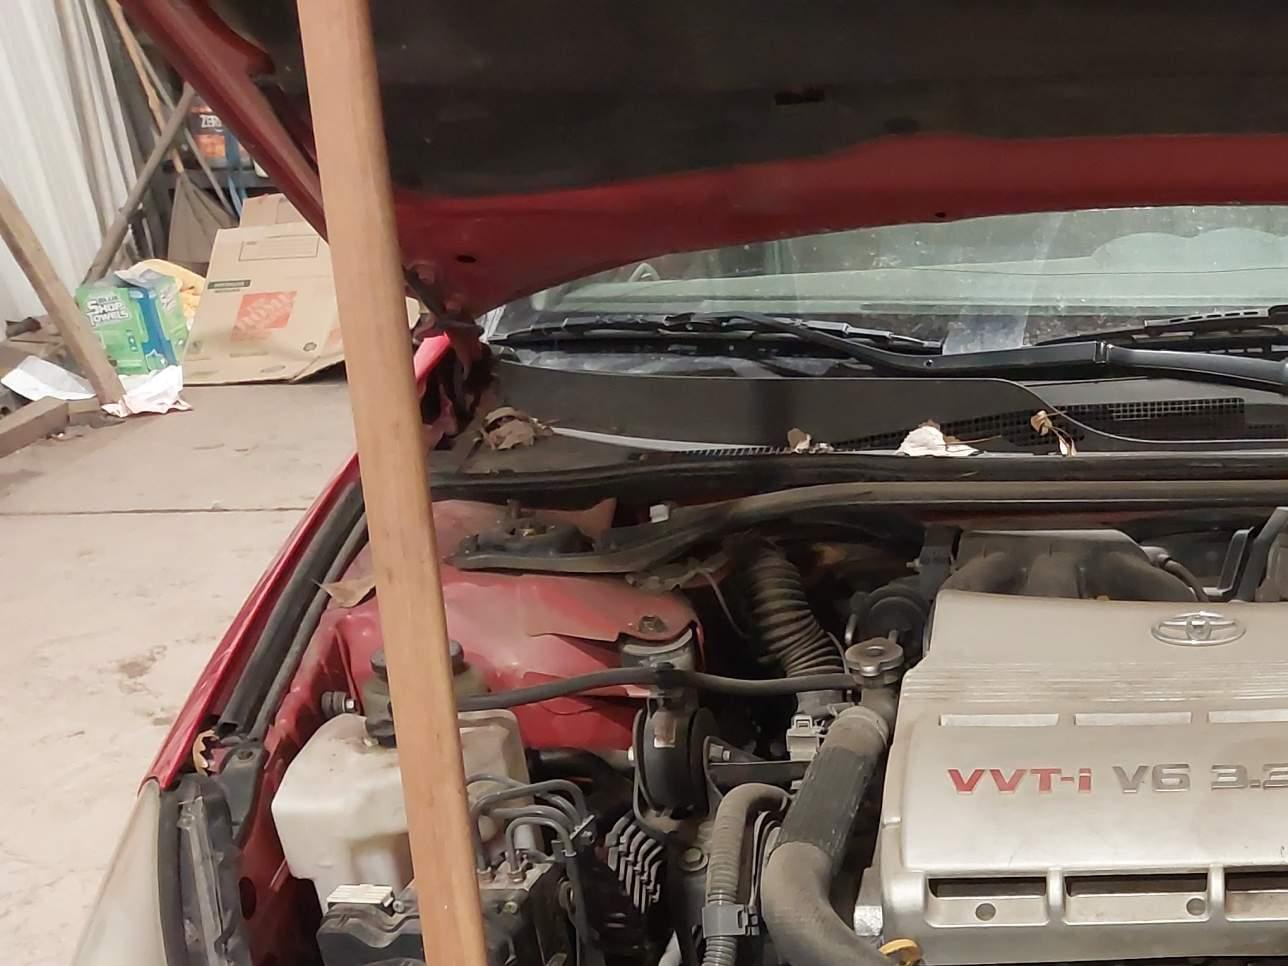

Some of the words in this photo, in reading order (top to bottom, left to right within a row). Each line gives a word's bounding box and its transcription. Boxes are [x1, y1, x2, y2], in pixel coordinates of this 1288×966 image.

[87, 299, 123, 314] SHOP
[86, 310, 129, 326] TOWELS
[947, 767, 1093, 795] VVT-i
[1112, 763, 1191, 794] V6
